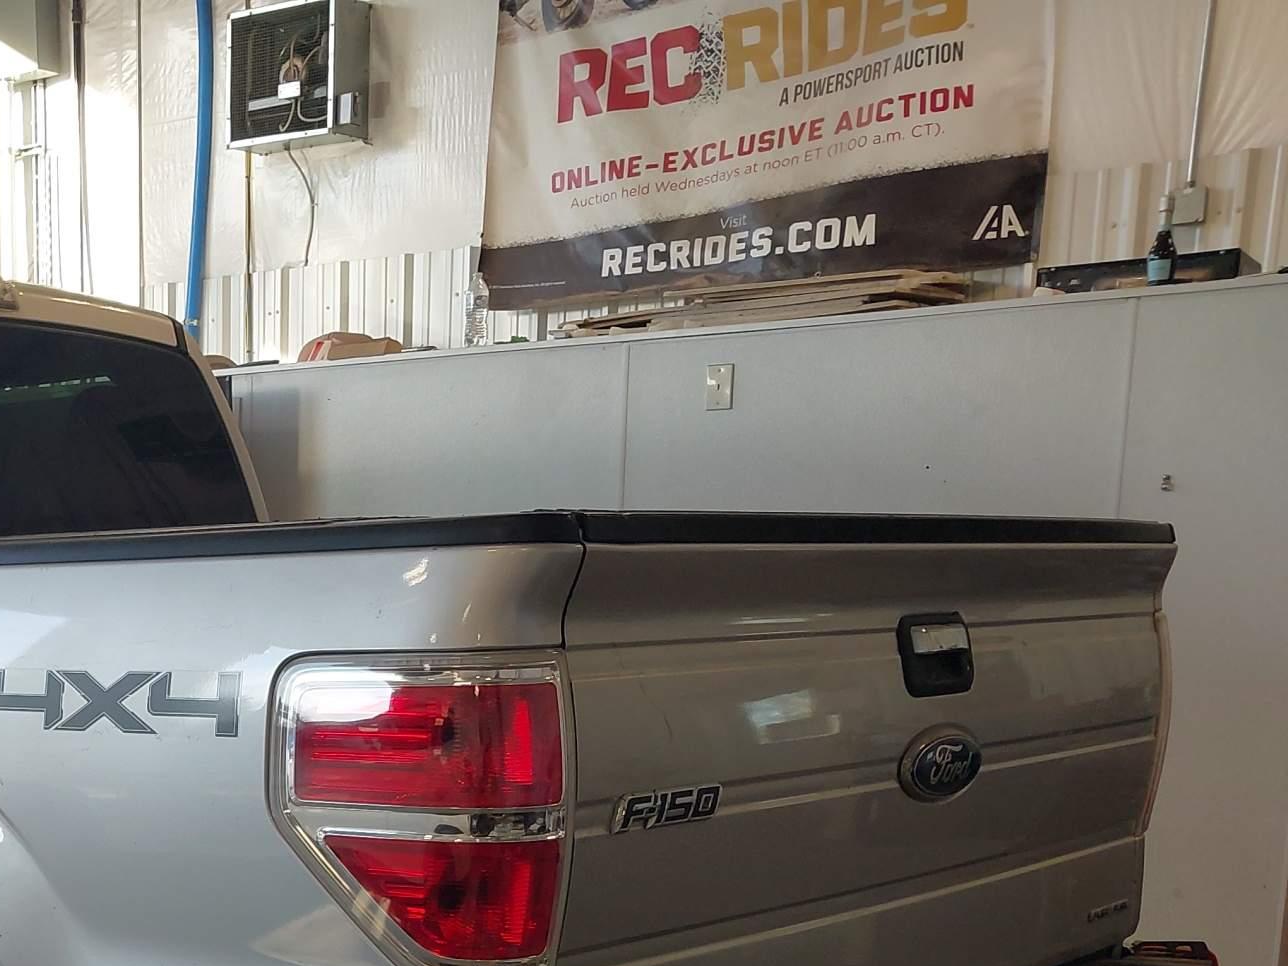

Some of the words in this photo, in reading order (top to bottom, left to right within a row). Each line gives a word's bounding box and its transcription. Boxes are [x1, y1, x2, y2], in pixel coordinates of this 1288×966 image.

[557, 24, 703, 124] REC
[779, 87, 789, 106] A
[793, 58, 892, 103] POWERSPORT
[893, 40, 965, 74] AUCTION
[551, 118, 825, 194] ONLINE-EXCLUSIVE
[834, 84, 974, 135] AUCTION
[570, 191, 618, 209] Auction
[621, 183, 650, 200] held
[655, 167, 740, 194] Wednesdays
[744, 163, 758, 176] at
[762, 156, 800, 171] noon
[804, 148, 824, 163] ET
[873, 130, 905, 145] a.m.
[911, 122, 945, 138] CT).
[601, 213, 877, 278] RECRIDES.COM
[720, 214, 747, 230] Visit
[929, 744, 973, 785] Ford
